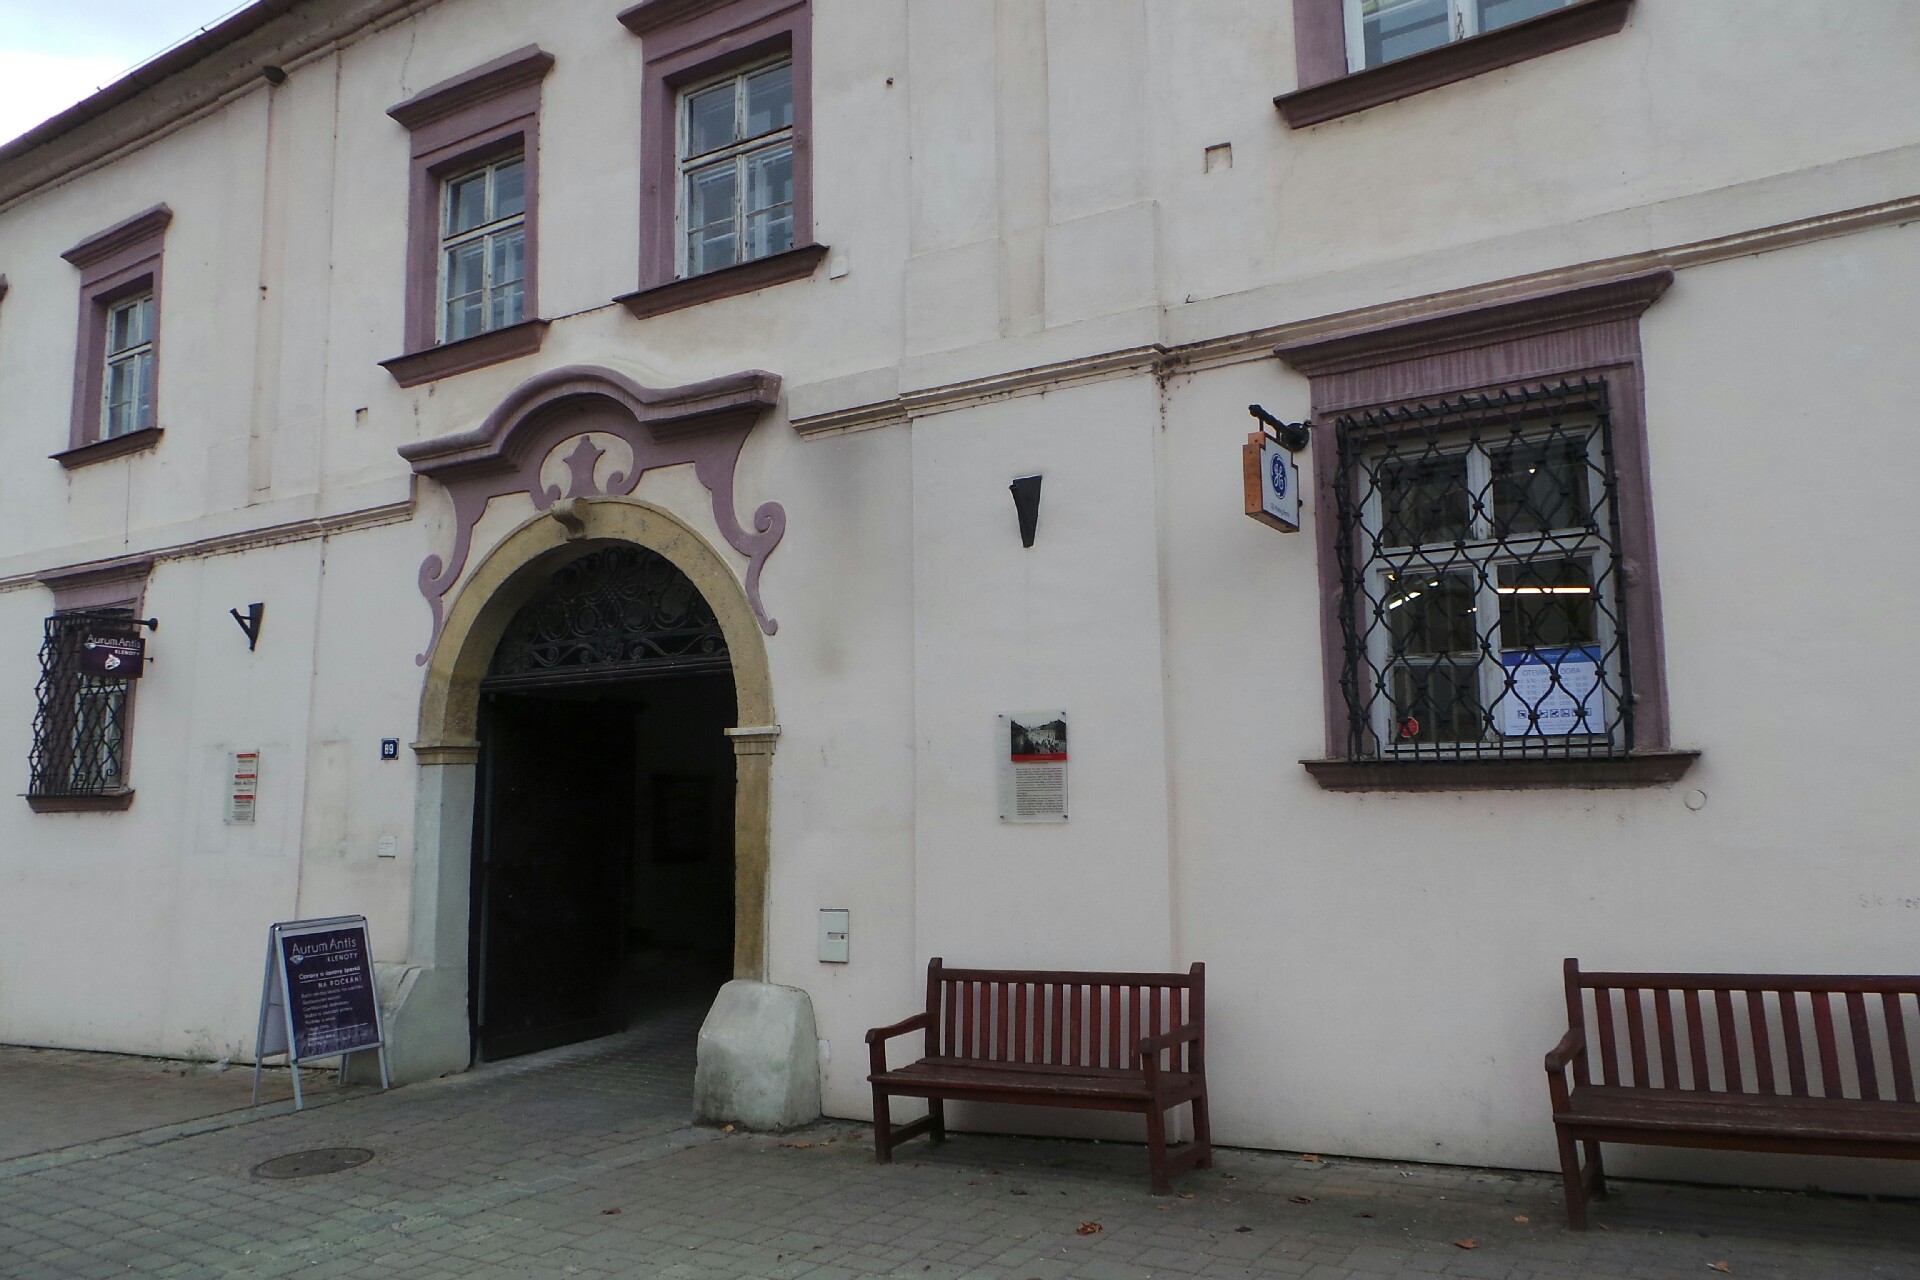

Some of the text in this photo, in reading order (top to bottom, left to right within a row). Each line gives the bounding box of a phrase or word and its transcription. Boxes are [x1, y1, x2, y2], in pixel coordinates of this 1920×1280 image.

[87, 633, 141, 649] Aurum Antis
[292, 937, 357, 955] Aurum Antis
[327, 953, 358, 963] KLENOTY
[330, 975, 362, 987] POČKÁNÍ
